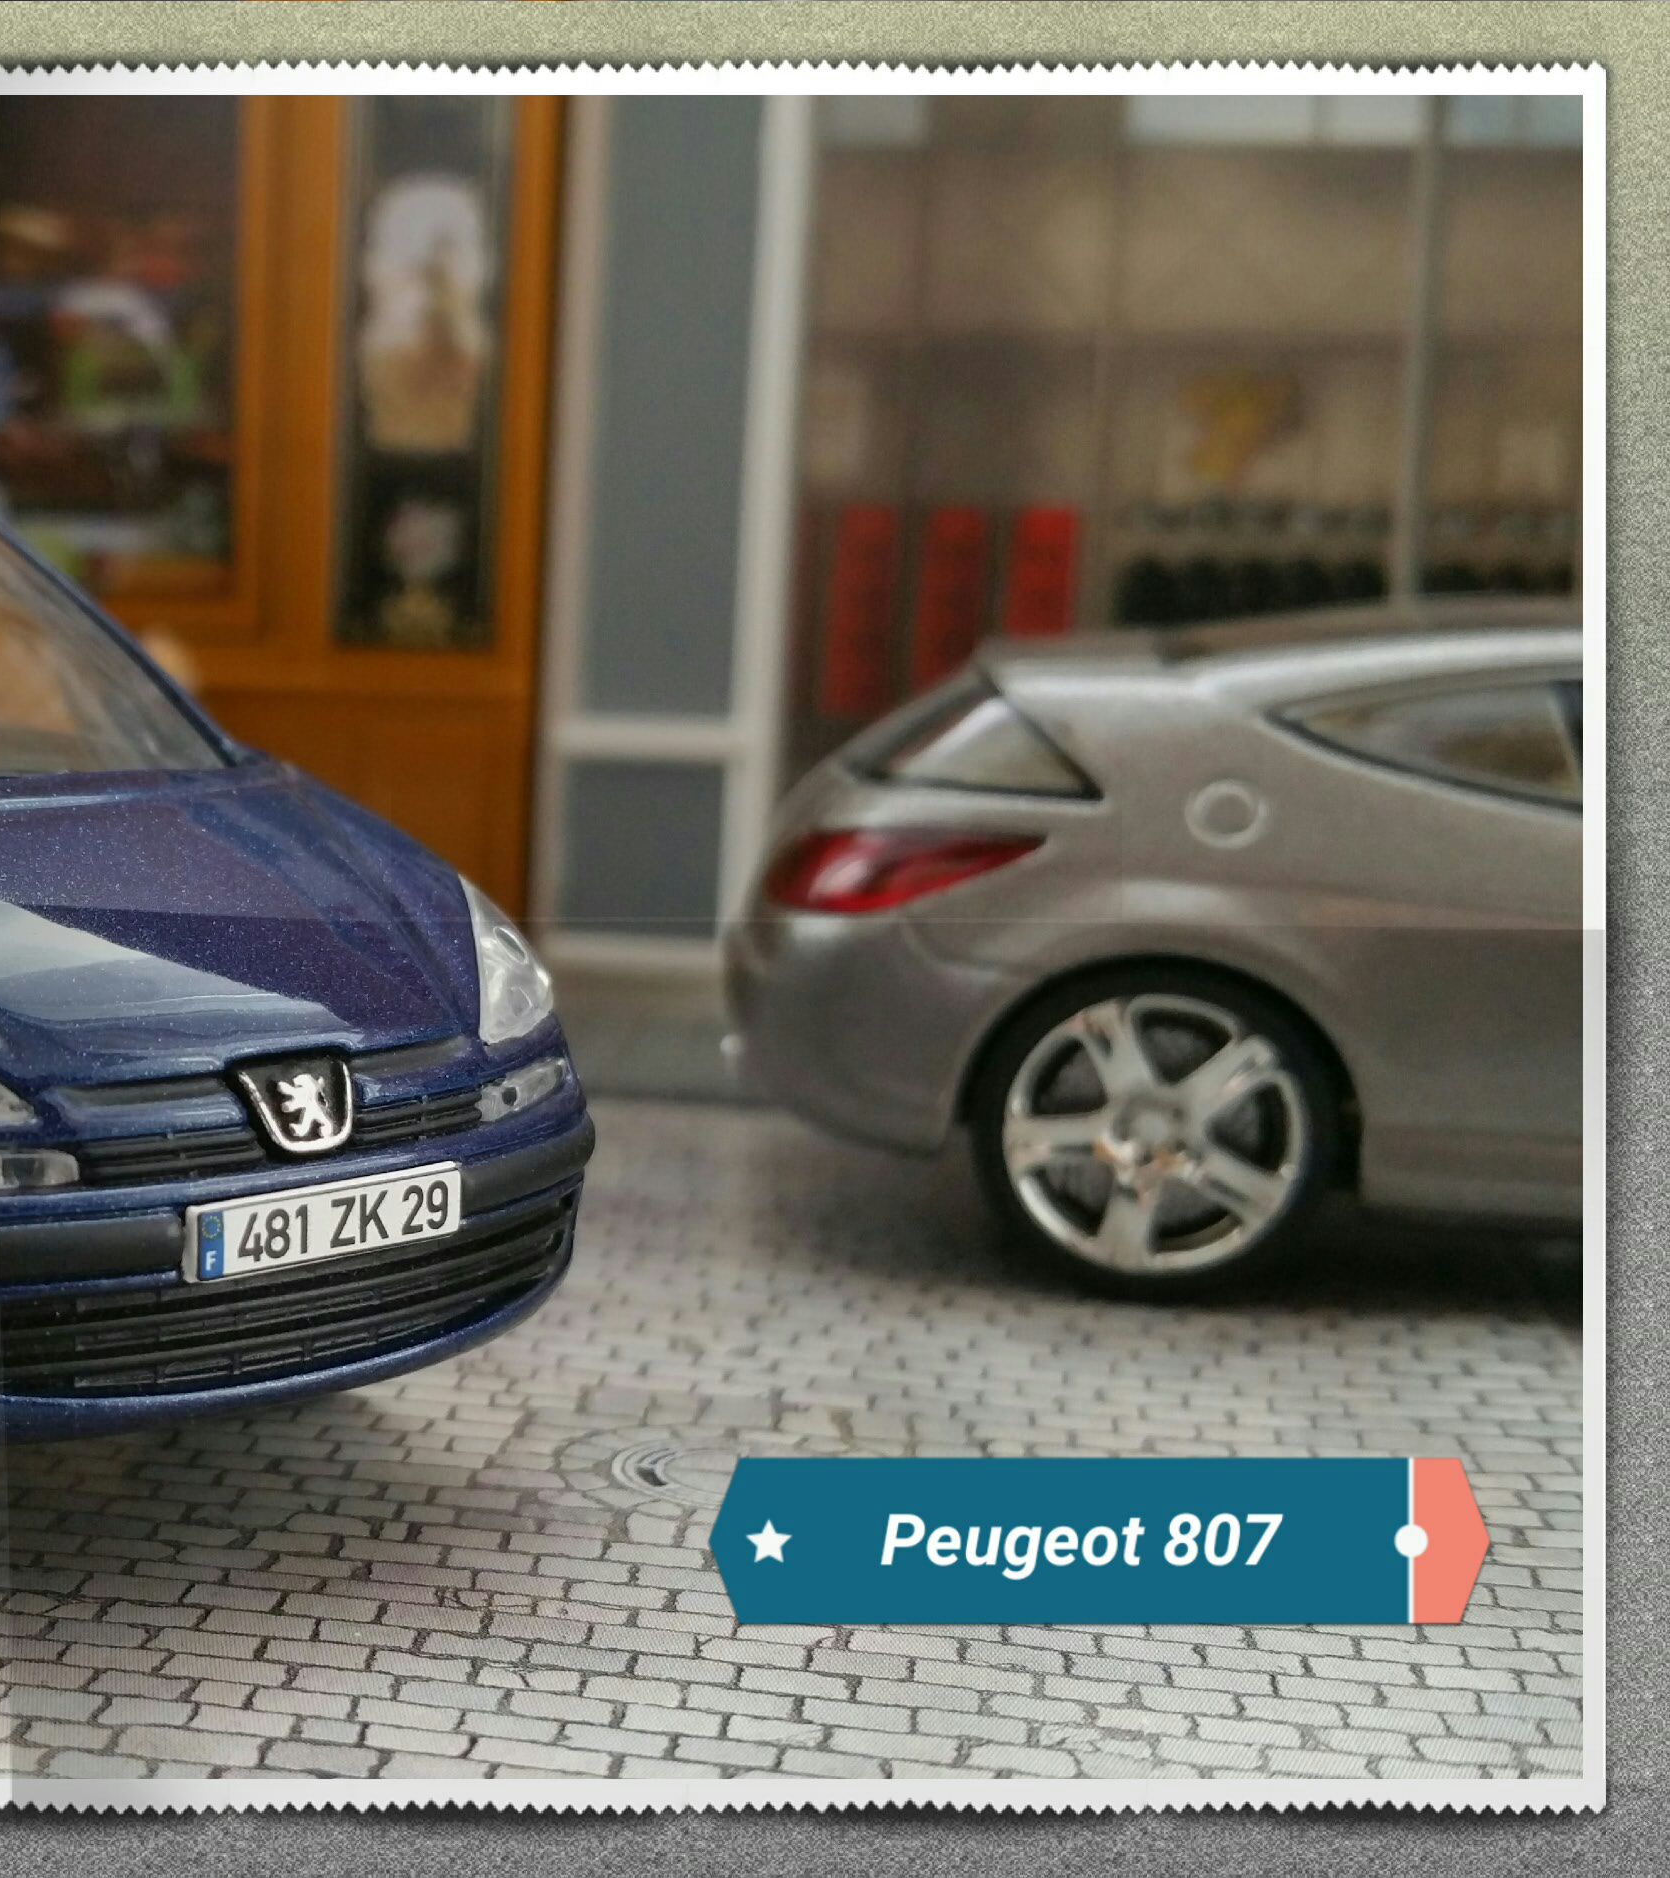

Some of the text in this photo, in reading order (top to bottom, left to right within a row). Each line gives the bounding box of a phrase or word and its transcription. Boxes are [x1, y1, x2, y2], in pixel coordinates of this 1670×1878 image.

[237, 1203, 309, 1262] 481
[330, 1189, 389, 1249] ZK
[401, 1180, 449, 1235] 29
